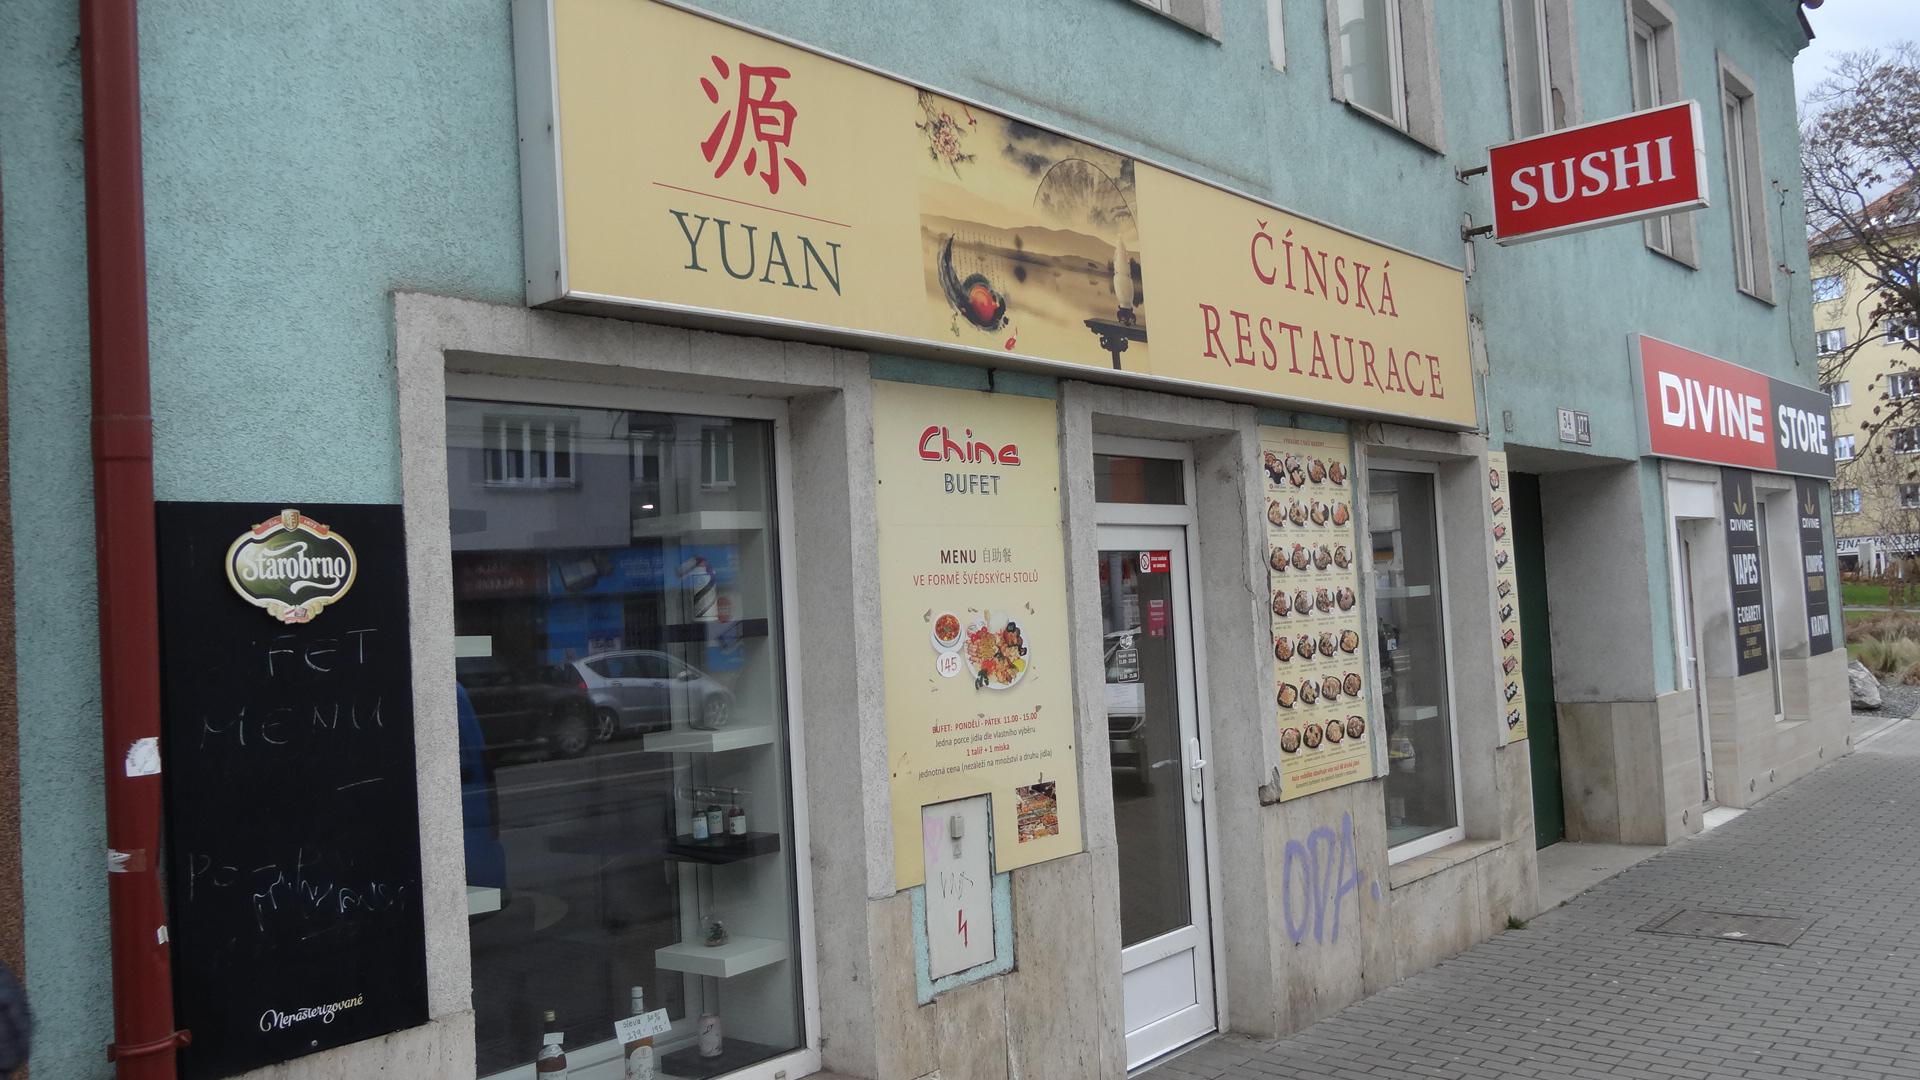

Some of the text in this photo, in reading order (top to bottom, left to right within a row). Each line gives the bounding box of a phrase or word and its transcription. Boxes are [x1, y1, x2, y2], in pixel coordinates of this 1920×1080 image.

[699, 54, 808, 196] 源
[1510, 135, 1679, 212] SUSHI
[669, 208, 842, 297] YUAN
[1250, 218, 1399, 318] ČÍNSKÁ
[1198, 302, 1445, 400] RESTAURACE
[1658, 370, 1829, 456] DIVINE STORE
[944, 472, 1001, 495] BUFET
[1729, 519, 1754, 531] DIVINE
[1802, 517, 1820, 529] DIVINE
[241, 541, 347, 594] Starobrno
[940, 549, 977, 564] MENU
[1732, 553, 1759, 585] VAPES
[913, 568, 1039, 587] VE FORMĚ ŠVÉDSKÝCH STOLŮ
[940, 656, 958, 674] 145
[932, 723, 953, 734] BUFET:
[260, 992, 364, 1032] Nepasterizované
